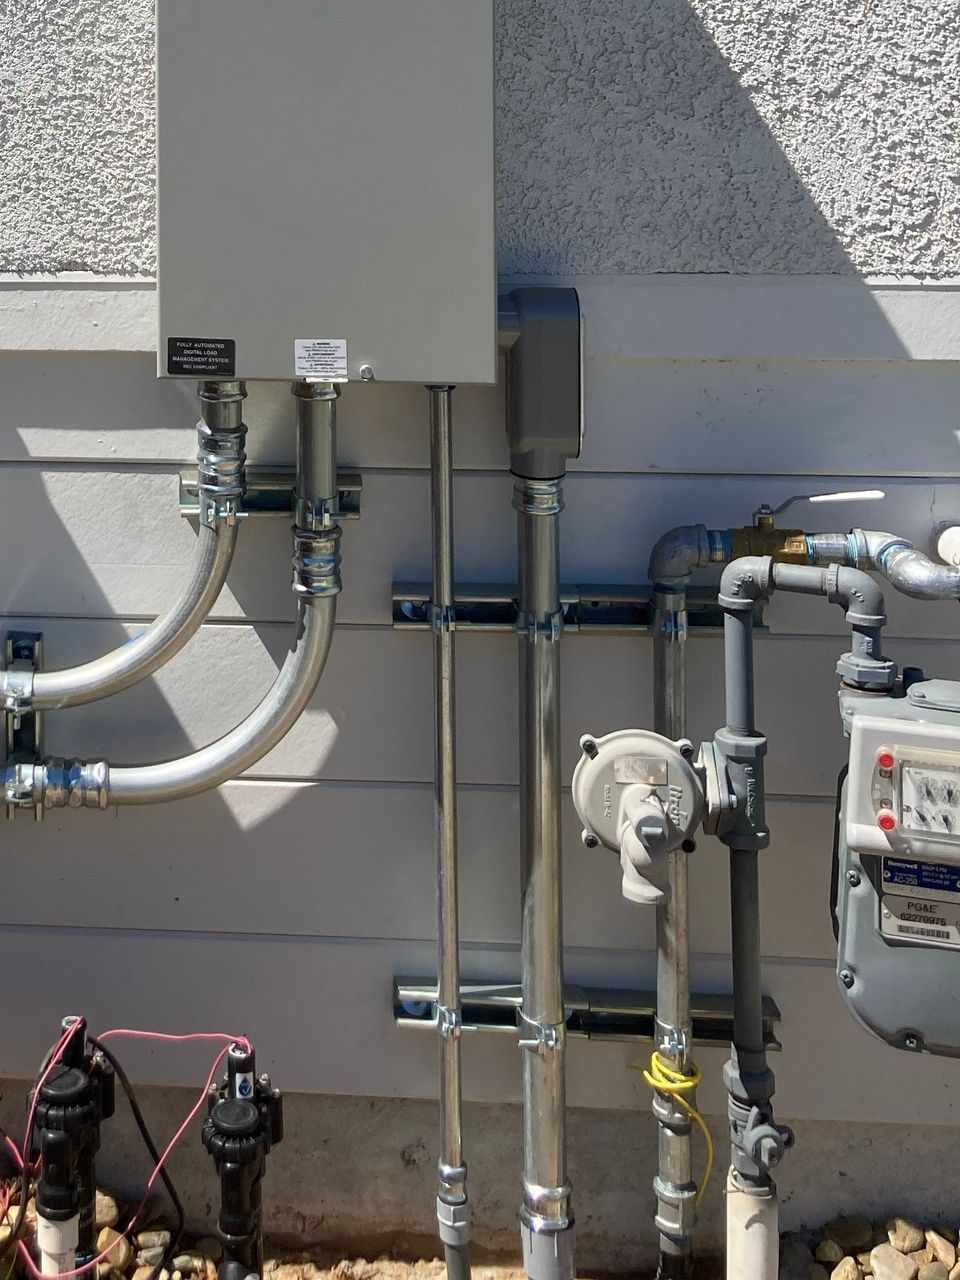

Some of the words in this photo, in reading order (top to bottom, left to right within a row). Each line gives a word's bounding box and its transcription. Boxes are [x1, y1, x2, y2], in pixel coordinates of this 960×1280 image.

[888, 860, 918, 869] Honeywell
[894, 876, 918, 885] AC-250
[907, 902, 936, 913] PG&E
[900, 913, 947, 926] 62270975
